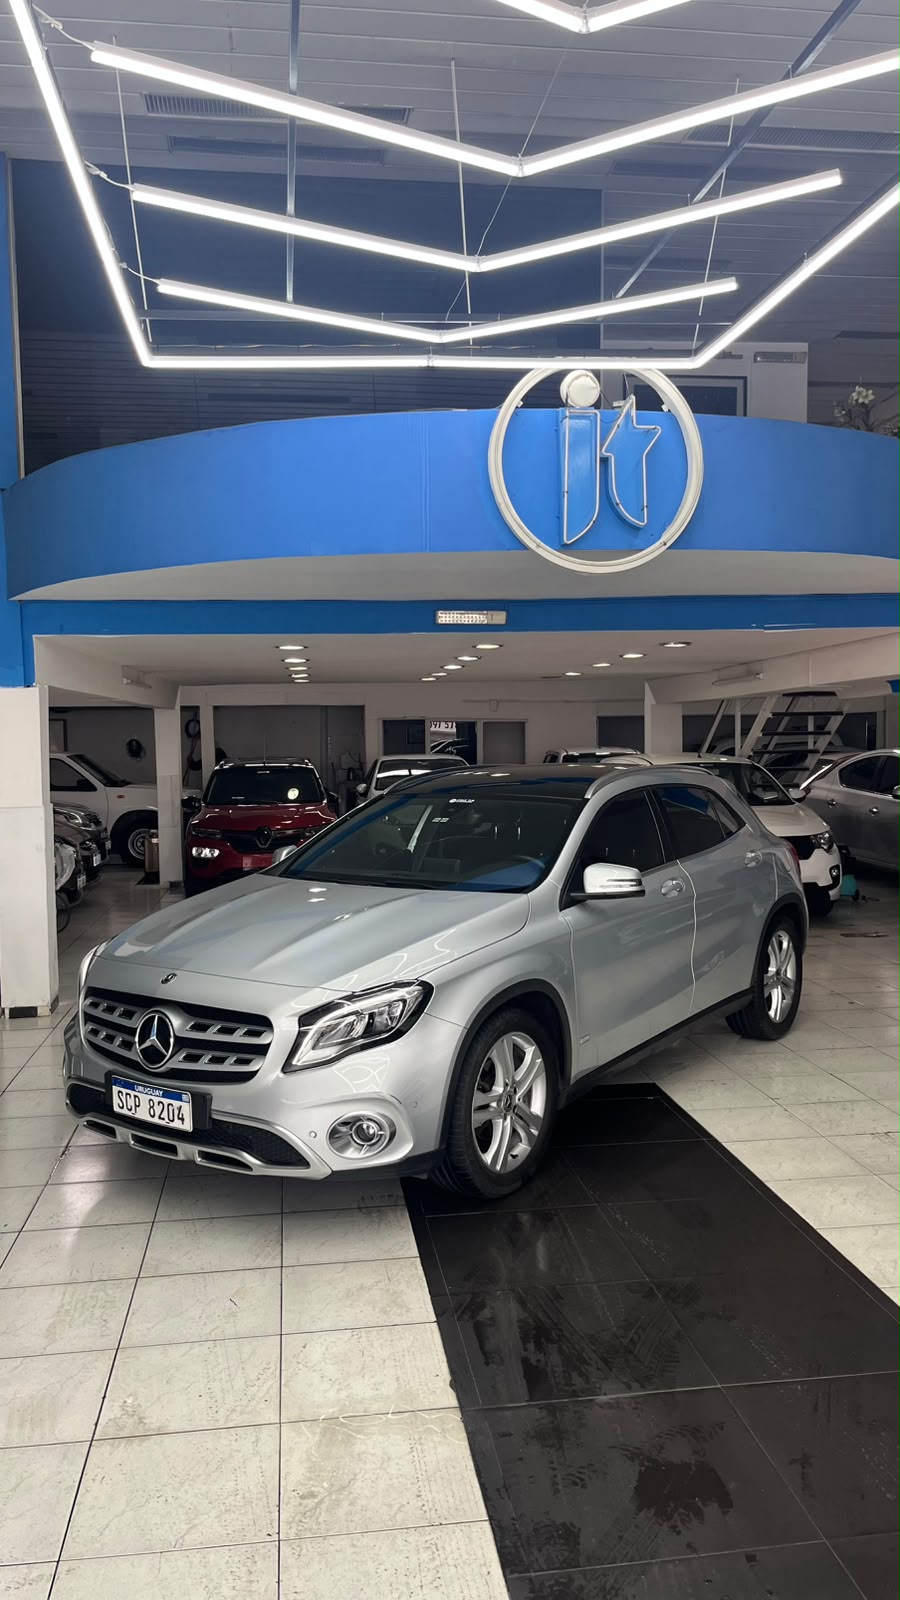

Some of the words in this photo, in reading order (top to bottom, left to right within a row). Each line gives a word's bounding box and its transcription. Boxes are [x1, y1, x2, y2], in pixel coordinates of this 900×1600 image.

[134, 1085, 163, 1097] URUGUAY
[117, 1090, 141, 1114] SCP
[148, 1098, 185, 1125] 8204
